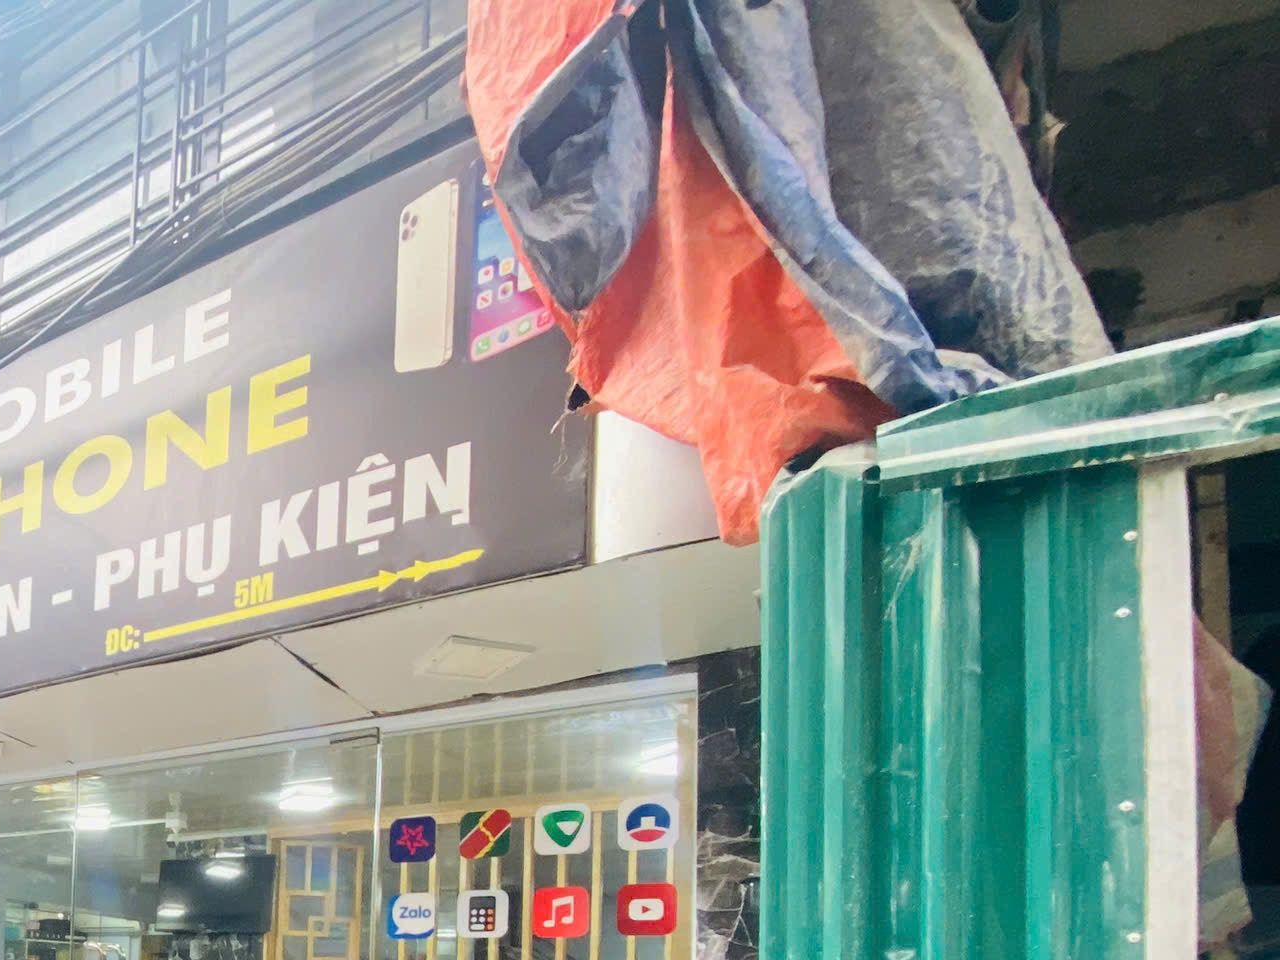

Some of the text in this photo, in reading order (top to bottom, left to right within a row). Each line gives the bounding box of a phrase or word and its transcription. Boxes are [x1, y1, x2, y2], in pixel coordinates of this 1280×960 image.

[93, 515, 231, 612] PHỤ
[259, 442, 472, 567] KIỆN
[234, 572, 274, 608] 5M
[399, 905, 432, 919] Zalo
